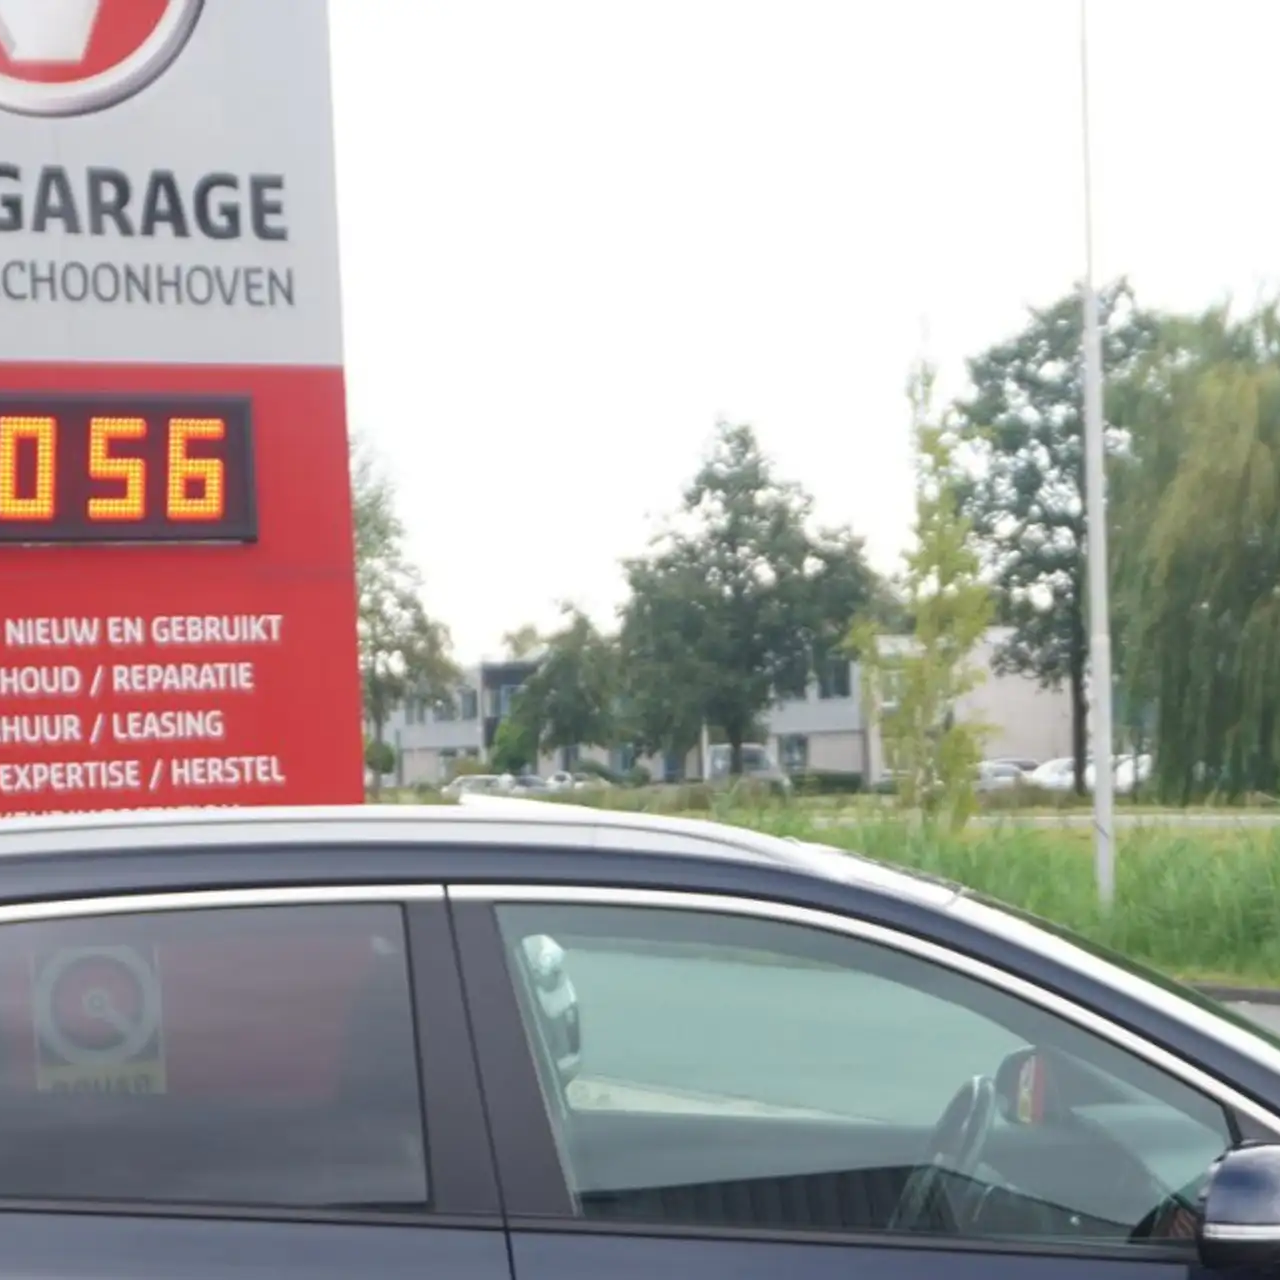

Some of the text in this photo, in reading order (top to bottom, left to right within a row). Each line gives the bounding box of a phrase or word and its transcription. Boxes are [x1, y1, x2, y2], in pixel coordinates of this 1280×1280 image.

[4, 616, 100, 646] NIEUW
[107, 616, 145, 645] EN
[150, 613, 283, 645] GEBRUIKT
[89, 665, 104, 697] /
[112, 662, 255, 692] REPARATIE
[89, 713, 104, 745] /
[112, 709, 225, 740] LEASING
[149, 758, 162, 791] /
[170, 755, 286, 786] HERSTEL
